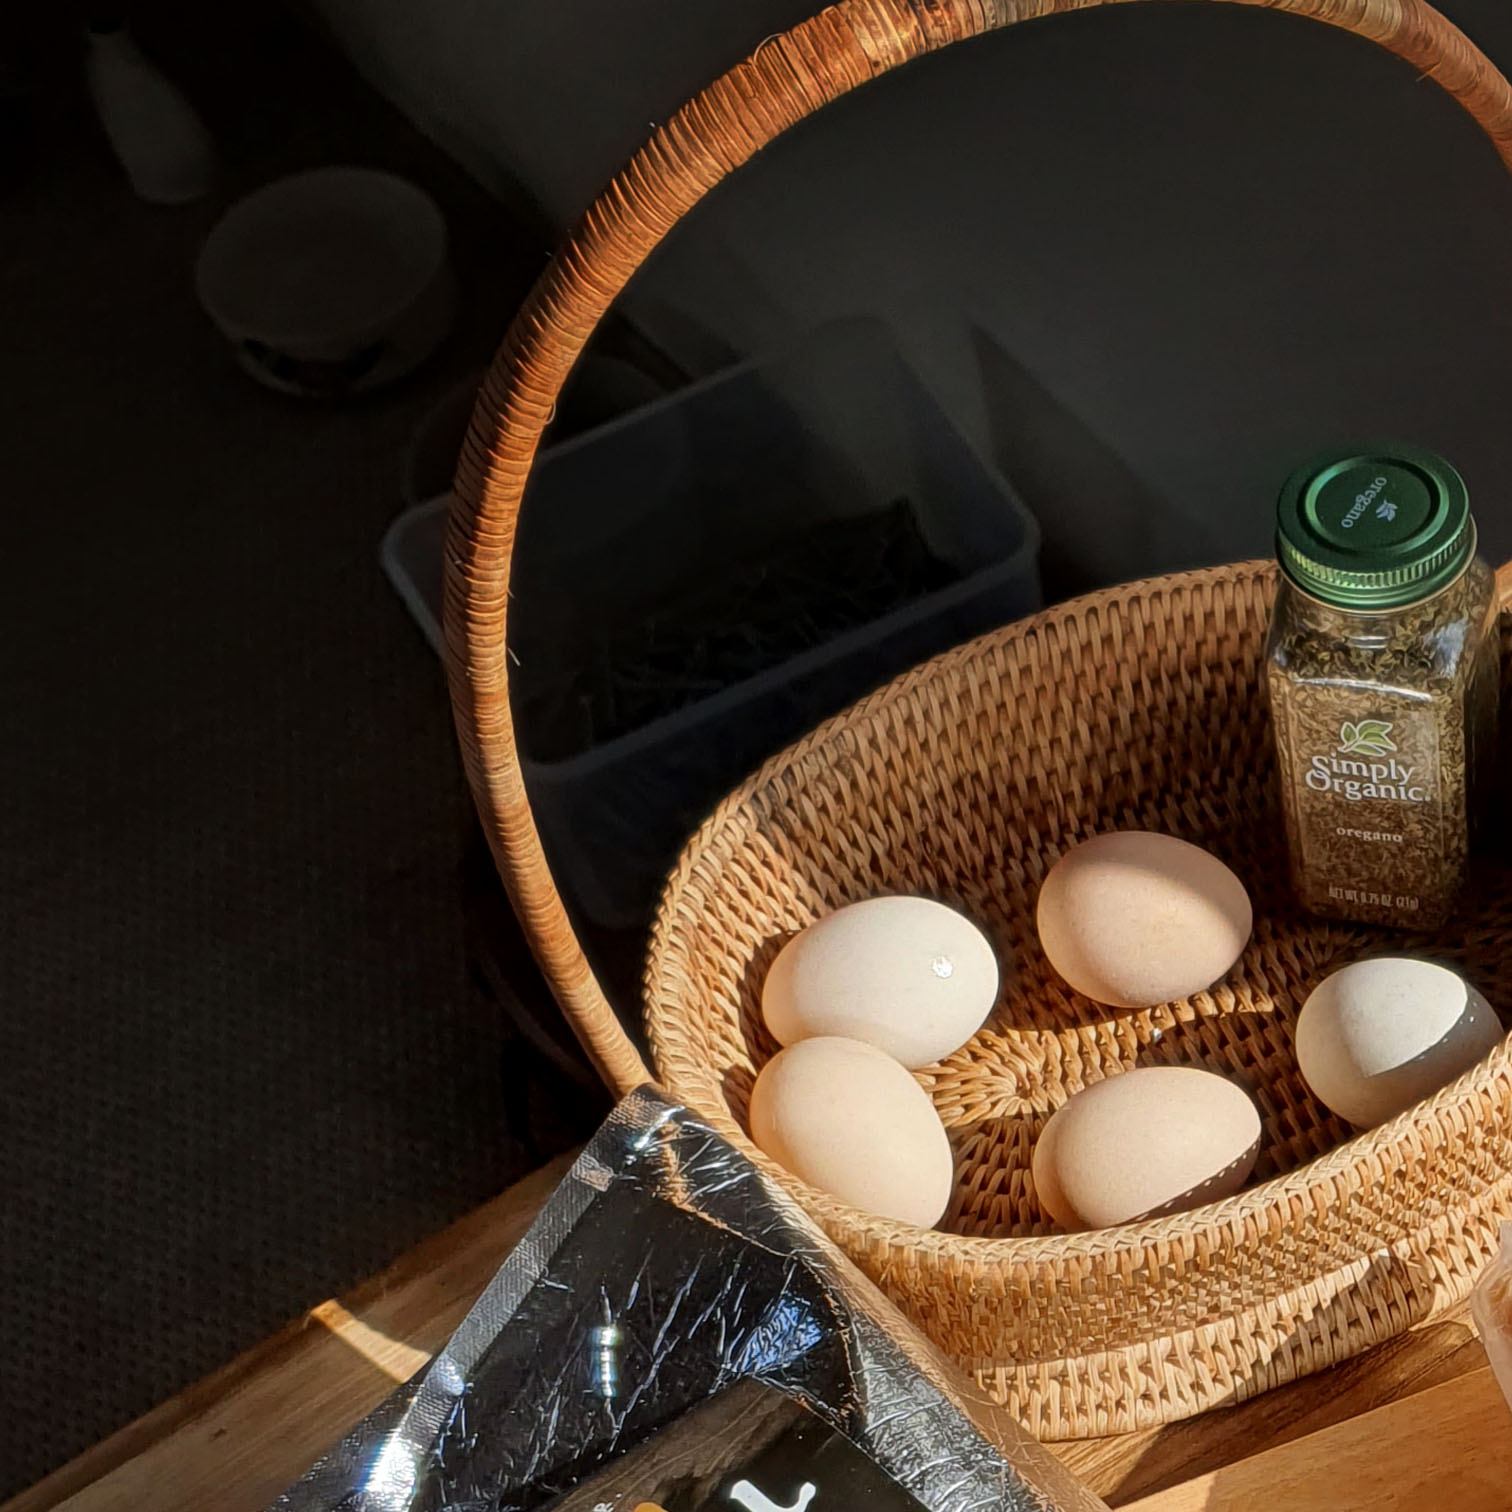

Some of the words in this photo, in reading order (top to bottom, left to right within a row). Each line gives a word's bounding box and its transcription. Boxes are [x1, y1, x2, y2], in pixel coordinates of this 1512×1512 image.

[1341, 477, 1388, 528] oregano
[1312, 752, 1416, 786] Simply
[1336, 826, 1403, 843] oregano
